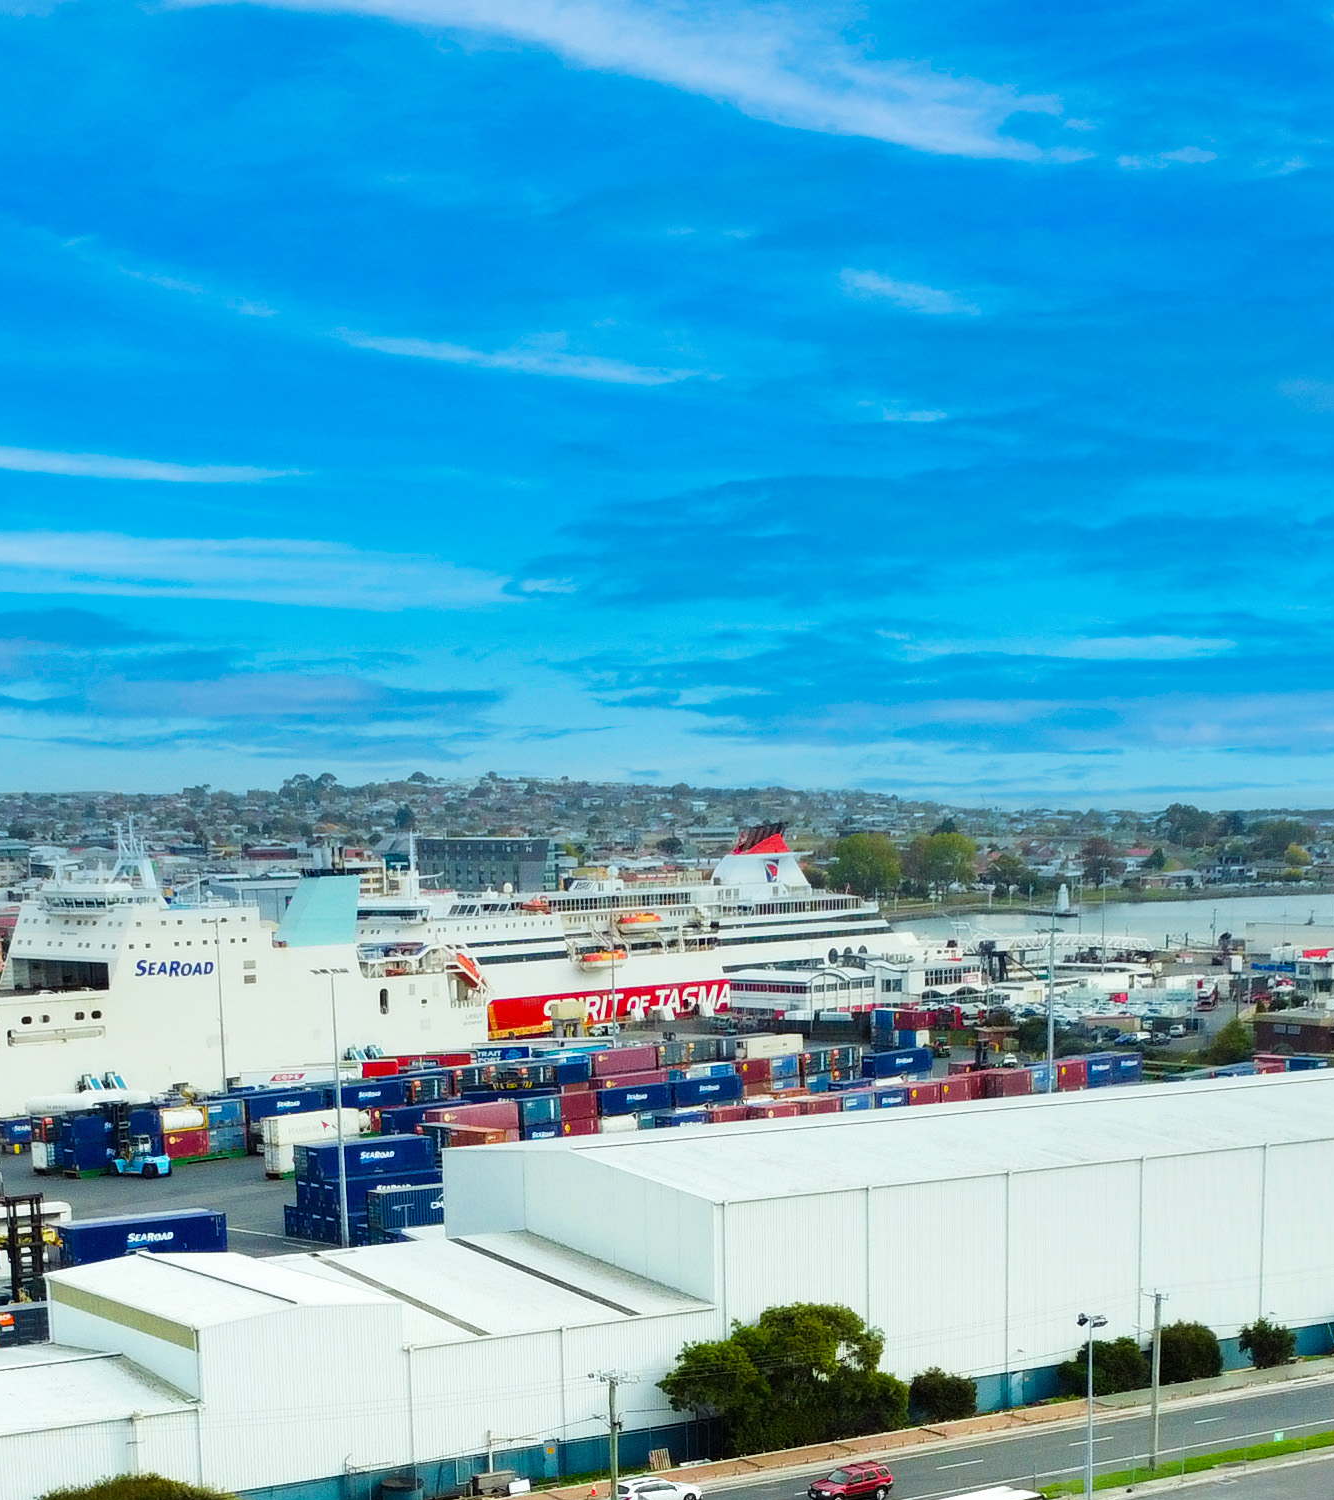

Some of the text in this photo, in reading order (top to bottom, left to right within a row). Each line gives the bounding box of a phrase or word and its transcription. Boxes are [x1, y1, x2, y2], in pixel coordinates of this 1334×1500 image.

[135, 960, 214, 977] SEAROAD
[543, 983, 730, 1021] SRIT OF TASMA
[275, 1074, 300, 1082] COPE
[360, 1151, 395, 1160] SEAROAD
[127, 1231, 174, 1242] SEAROAD
